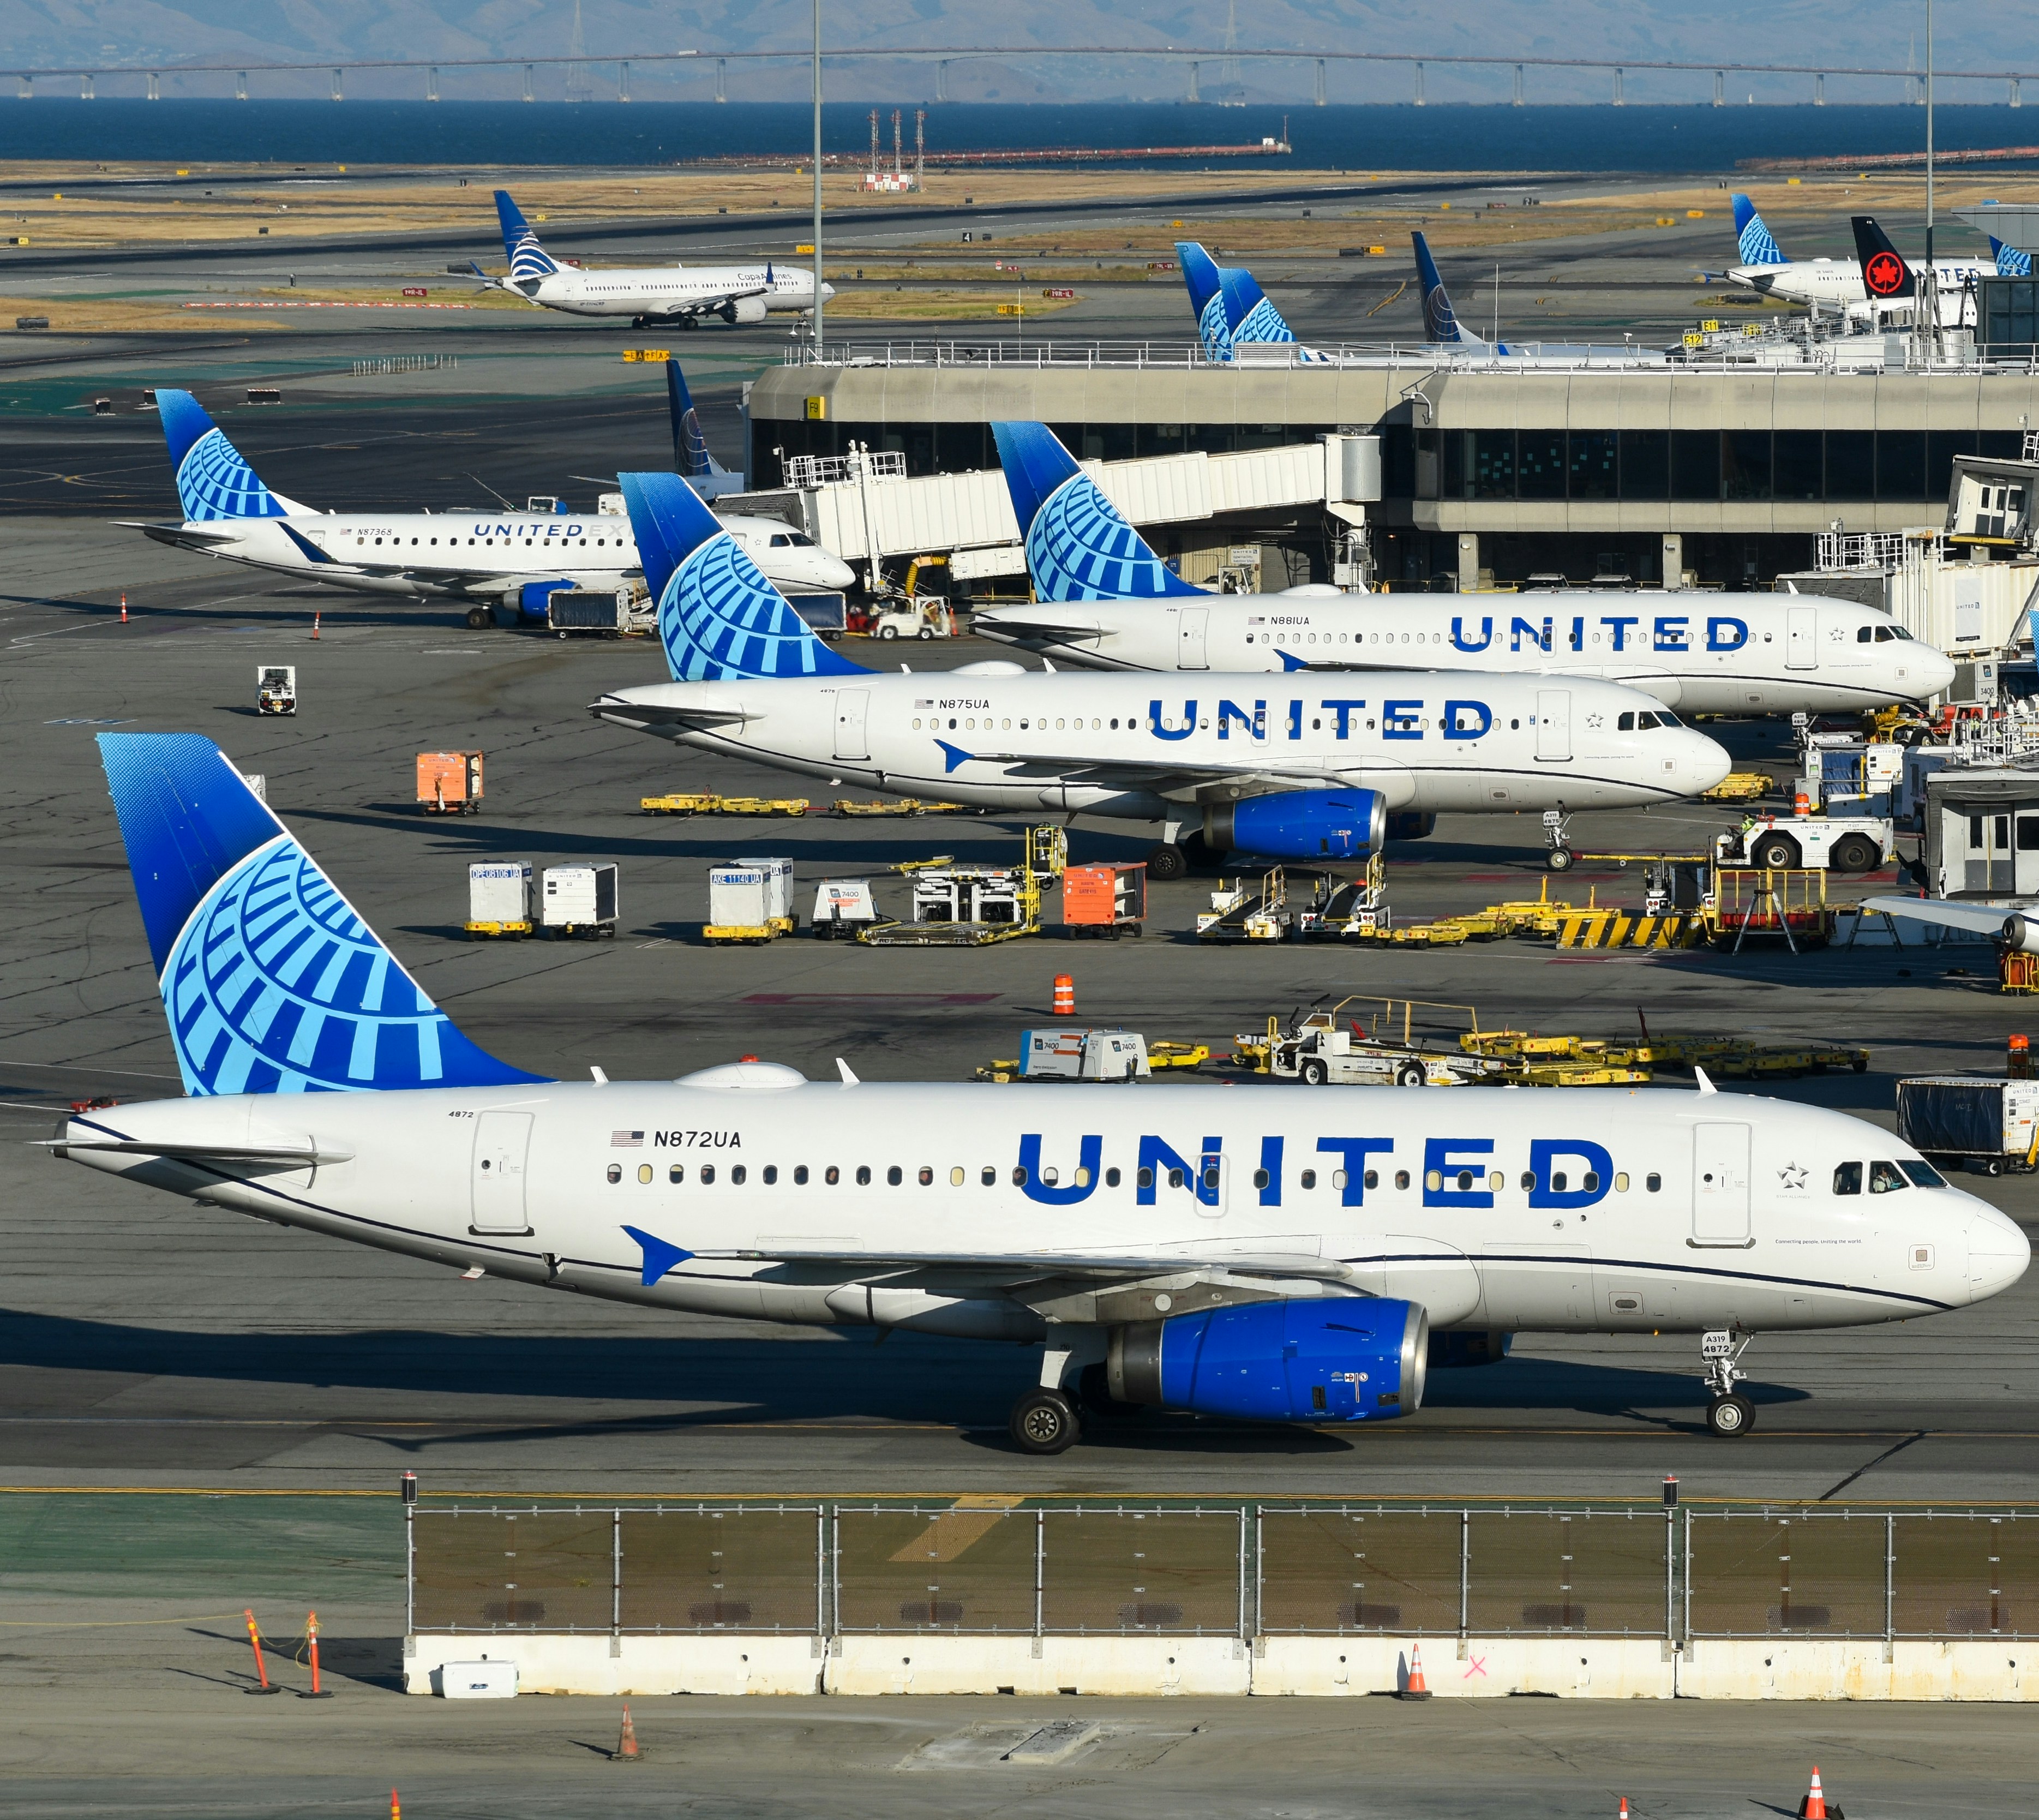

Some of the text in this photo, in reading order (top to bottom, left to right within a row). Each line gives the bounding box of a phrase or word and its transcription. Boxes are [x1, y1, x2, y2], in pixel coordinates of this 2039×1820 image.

[964, 233, 970, 241] 4
[737, 272, 792, 281] CopaAlines
[1704, 321, 1717, 331] E11
[809, 403, 818, 413] F9
[474, 524, 583, 536] UNITED
[1270, 616, 1310, 625] N881UA
[1450, 616, 1749, 652] UNITED
[1981, 687, 1994, 695] 3400
[939, 699, 989, 709] N875UA
[1148, 699, 1493, 741] UNITED
[510, 869, 520, 878] UA
[770, 867, 780, 876] UA
[751, 875, 760, 883] UA
[654, 1131, 741, 1148] N872UA
[1018, 1133, 1614, 1210] UNITED
